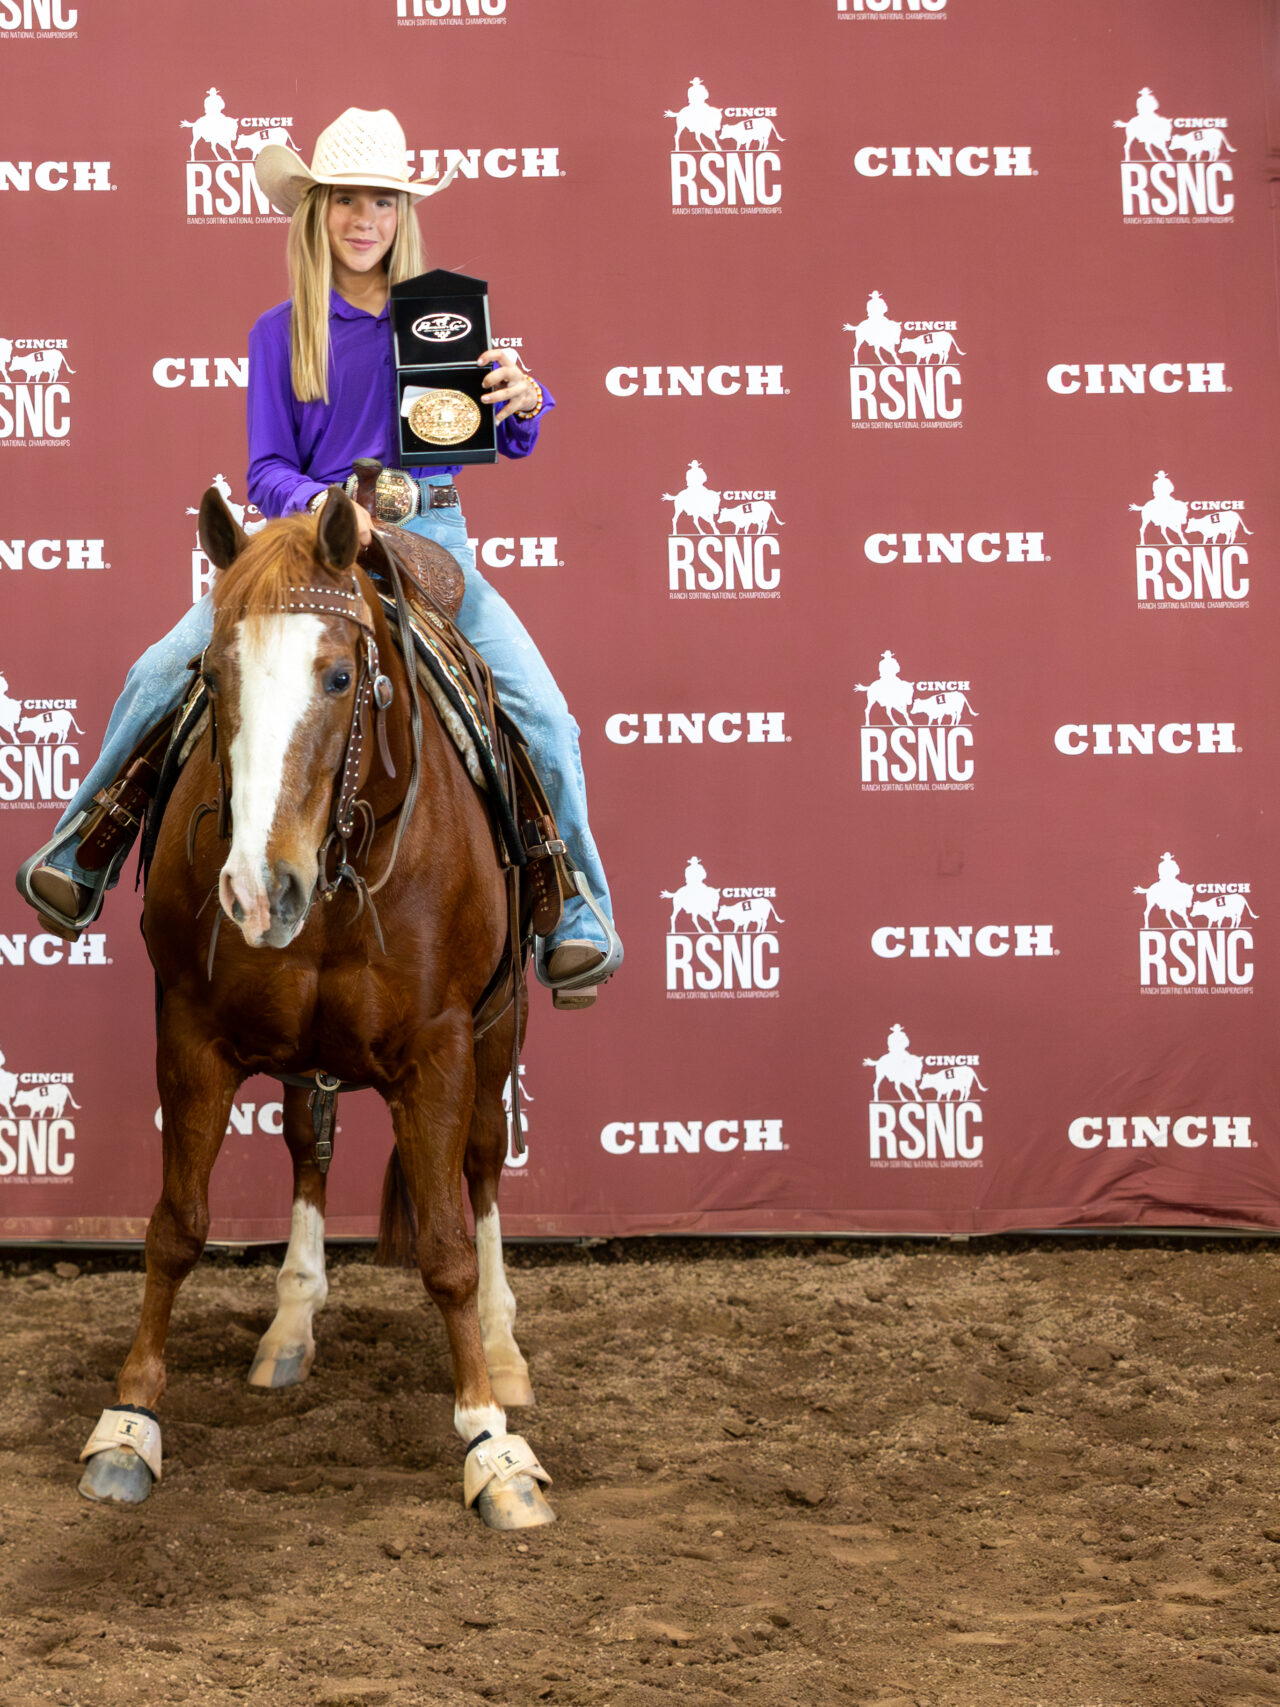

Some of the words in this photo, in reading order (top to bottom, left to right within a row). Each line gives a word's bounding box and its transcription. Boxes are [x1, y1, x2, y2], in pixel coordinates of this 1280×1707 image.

[241, 117, 293, 127] CINCH
[724, 107, 777, 117] CINCH
[1174, 118, 1227, 127] CINCH
[854, 147, 1031, 176] CINCH
[186, 163, 286, 215] RSN
[670, 152, 781, 205] RSNC
[1121, 162, 1233, 215] RSNC
[904, 321, 957, 330] CINCH
[15, 339, 68, 349] CINCH
[152, 357, 249, 388] CIN
[606, 366, 782, 396] CINCH
[1047, 363, 1224, 394] CINCH
[850, 366, 962, 420] RSNC
[723, 490, 776, 500] CINCH
[1190, 500, 1244, 510] CINCH
[668, 536, 780, 590] RSNC
[865, 532, 1043, 563] CINCH
[1136, 546, 1249, 600] RSNC
[916, 681, 970, 691] CINCH
[24, 699, 77, 709] CINCH
[605, 712, 784, 744] CINCH
[1055, 723, 1234, 755] CINCH
[860, 727, 974, 782] RSNC
[722, 887, 776, 897] CINCH
[1196, 883, 1250, 893] CINCH
[872, 926, 1052, 958] CINCH
[1139, 930, 1254, 985] RSNC
[665, 934, 779, 990] RSNC
[925, 1055, 979, 1065] CINCH
[20, 1073, 74, 1083] CINCH
[601, 1120, 782, 1154] CINCH
[869, 1102, 983, 1159] RSNC
[1069, 1116, 1250, 1148] CINCH
